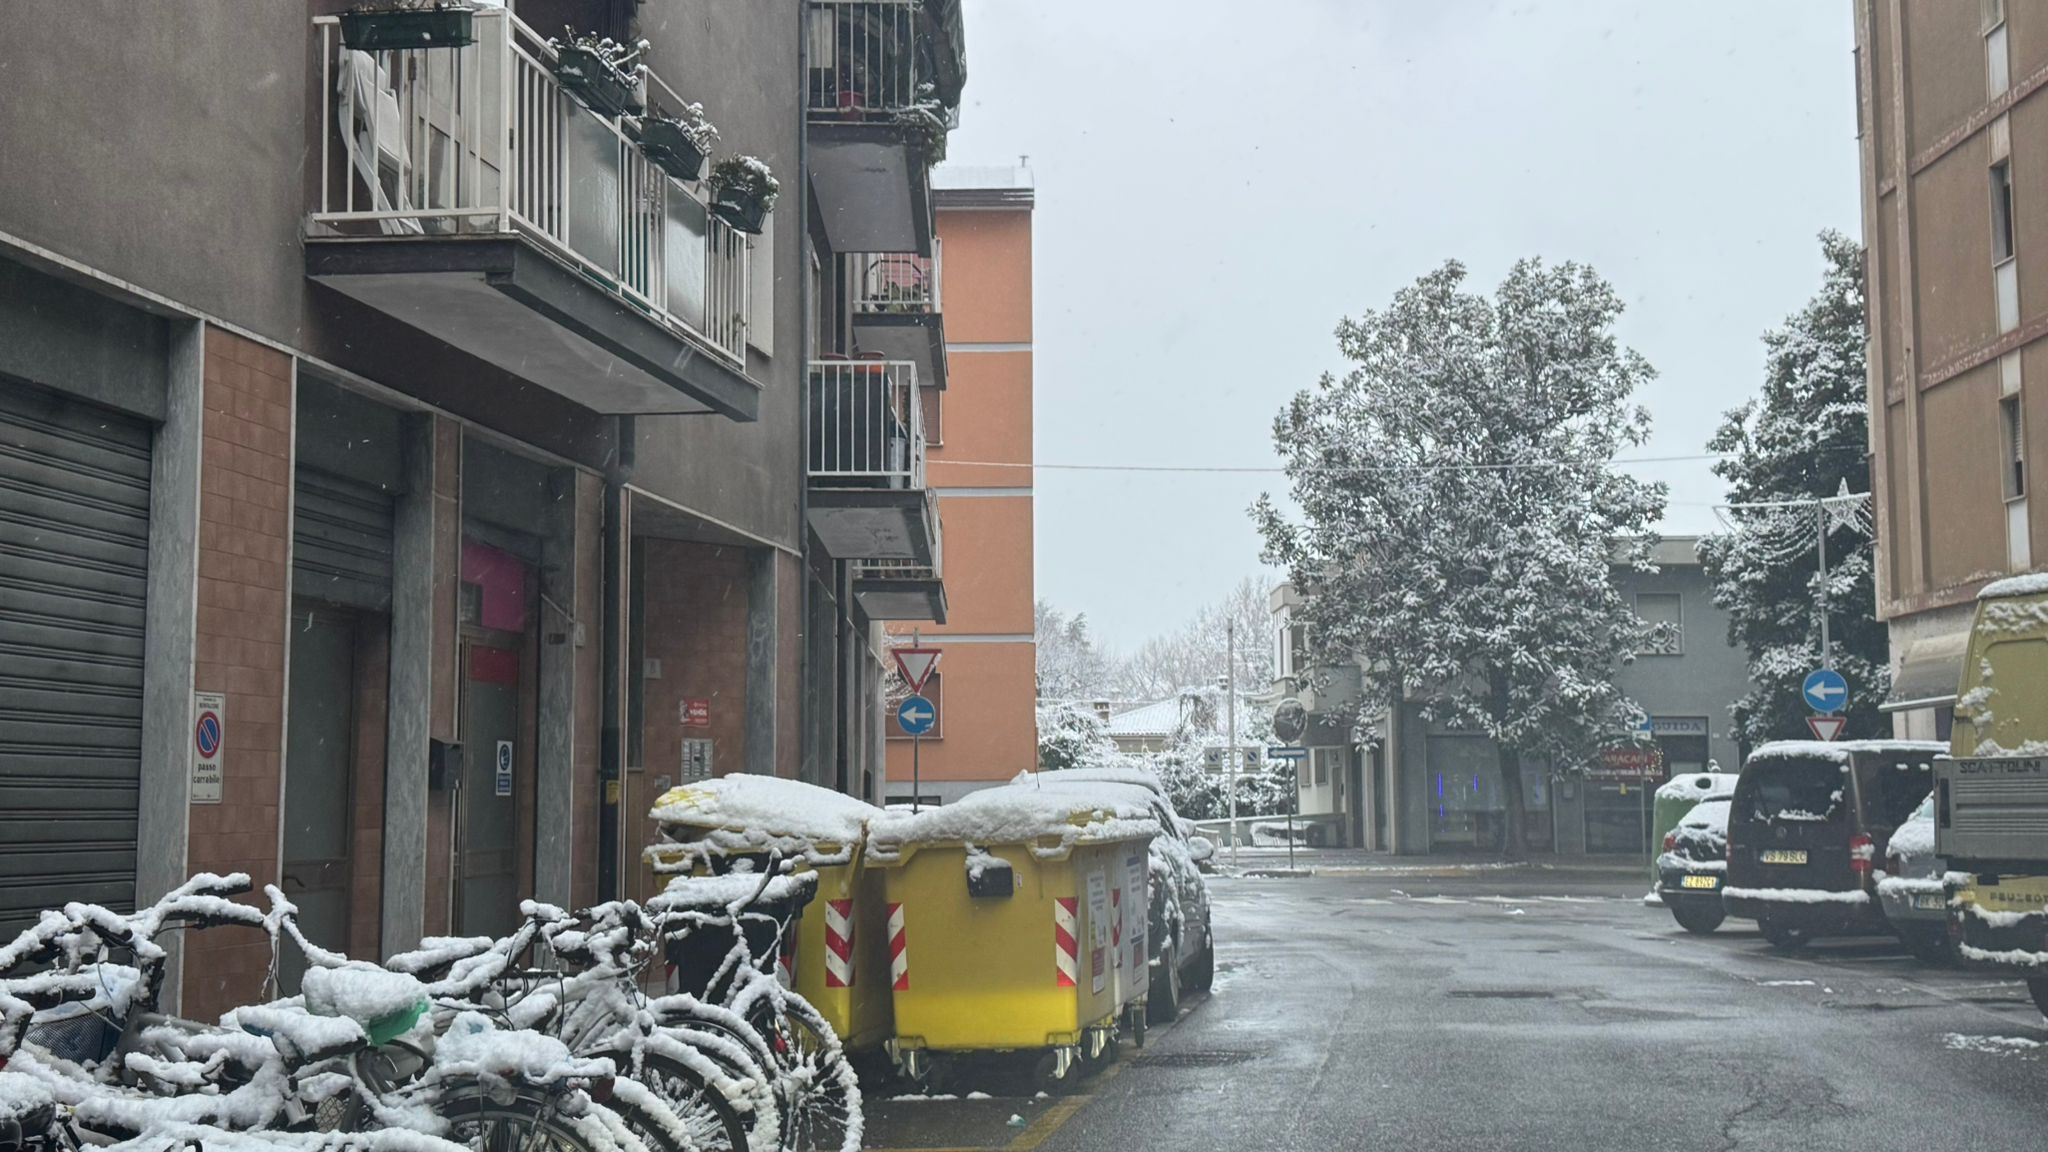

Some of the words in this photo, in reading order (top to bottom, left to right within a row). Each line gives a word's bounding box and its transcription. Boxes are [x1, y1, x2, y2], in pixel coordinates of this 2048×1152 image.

[198, 763, 216, 772] passo
[1960, 760, 2040, 774] SCATTOLINI
[193, 774, 220, 784] carrabile
